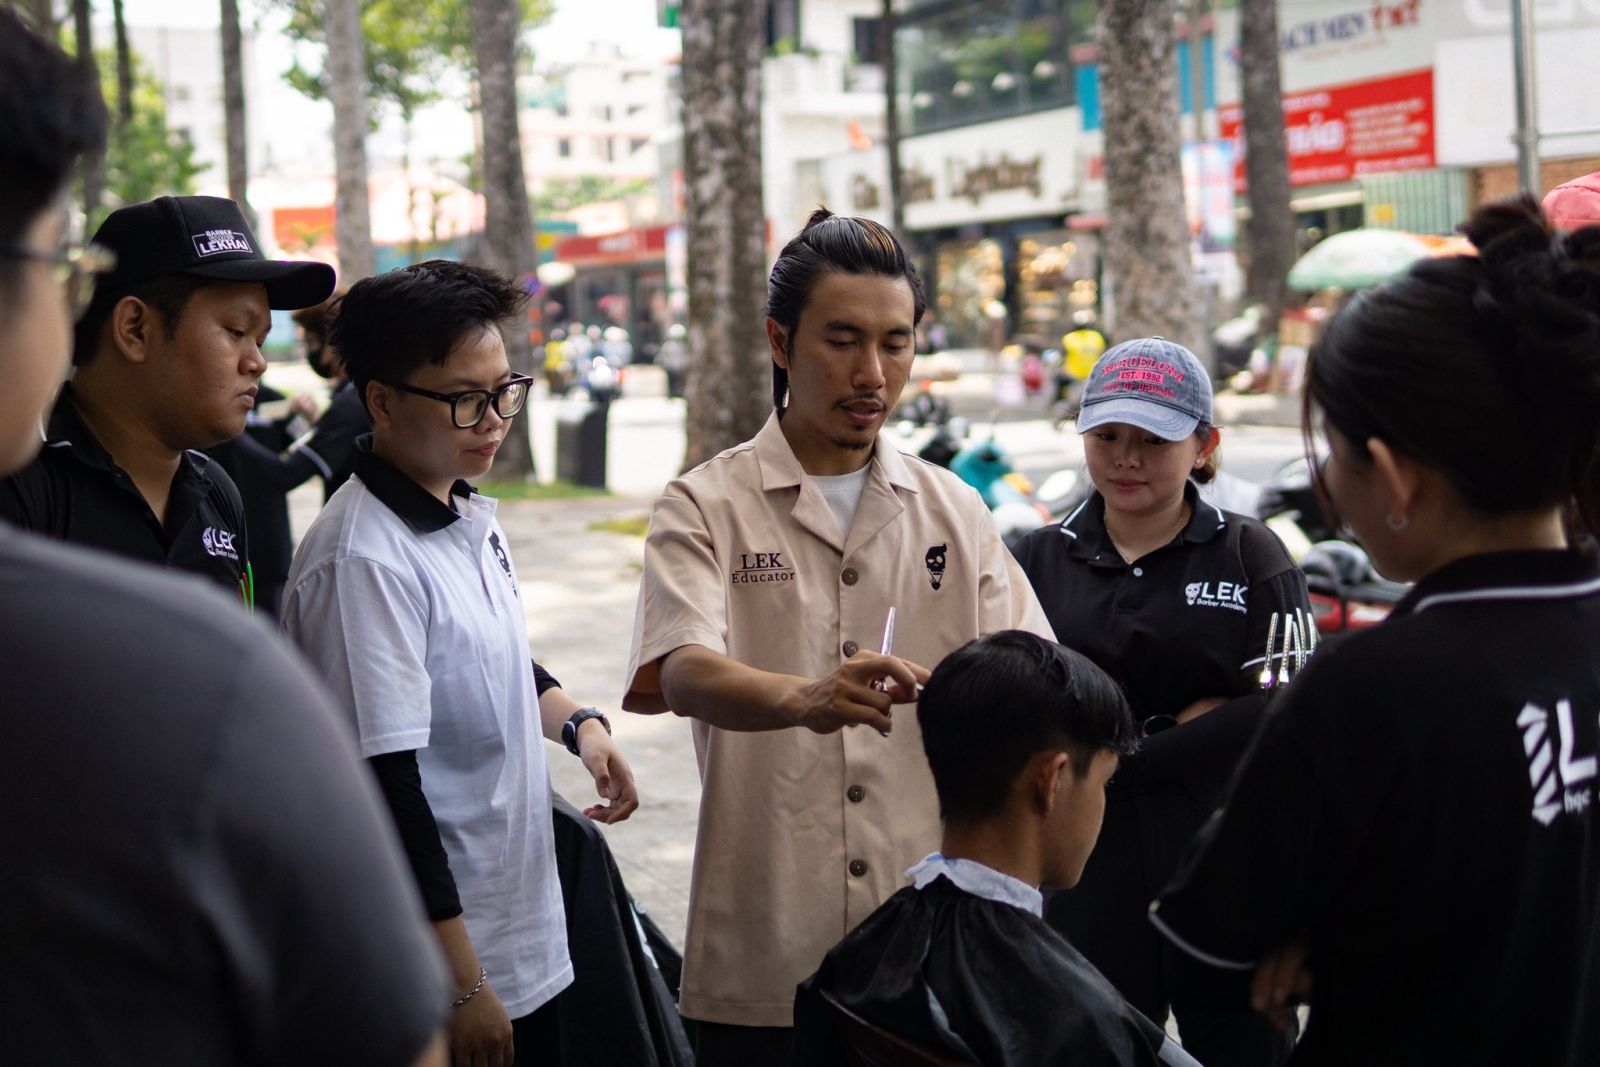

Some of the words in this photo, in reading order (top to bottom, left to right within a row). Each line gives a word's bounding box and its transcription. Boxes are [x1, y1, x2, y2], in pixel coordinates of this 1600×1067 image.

[200, 239, 249, 254] LEKHAI
[1102, 356, 1184, 382] BARCELONA
[1120, 370, 1138, 380] EST.
[1142, 371, 1161, 383] 1992
[1124, 380, 1135, 391] OF
[212, 528, 236, 552] LEK
[741, 553, 784, 570] LEK
[731, 572, 796, 584] Educator
[1202, 581, 1248, 604] LEK
[1197, 598, 1219, 607] Barber
[1220, 601, 1247, 614] Academy
